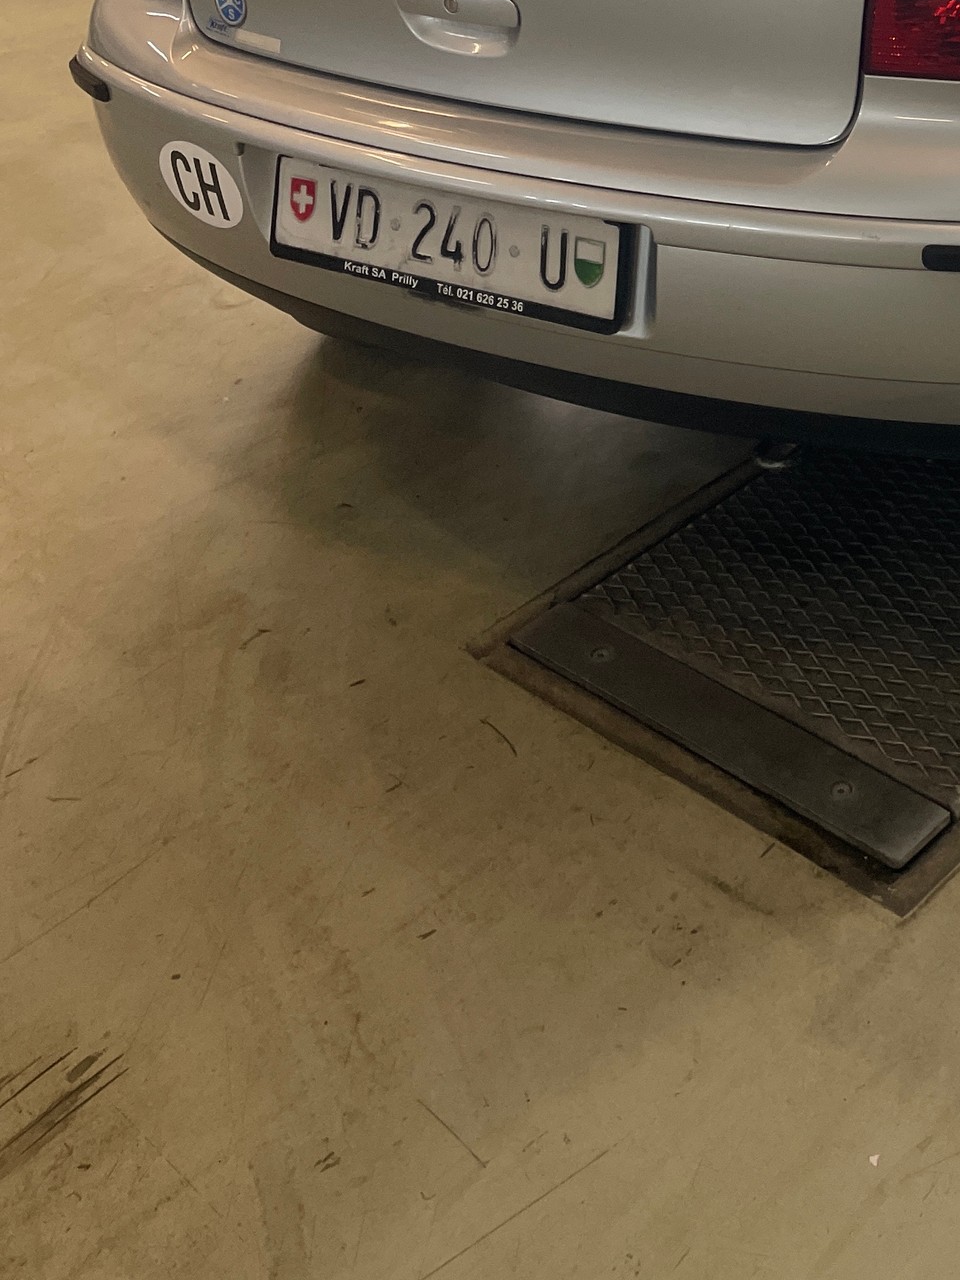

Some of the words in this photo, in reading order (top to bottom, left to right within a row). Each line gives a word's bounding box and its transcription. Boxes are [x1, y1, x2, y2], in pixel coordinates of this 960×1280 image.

[170, 150, 230, 221] CH
[330, 179, 381, 249] VD
[411, 199, 496, 275] 240
[539, 224, 569, 291] U
[344, 261, 370, 275] Kraft
[371, 268, 386, 279] SA
[391, 272, 419, 288] Prilly
[436, 283, 454, 297] Tél.
[456, 288, 473, 301] 021
[476, 293, 494, 306] 626
[496, 297, 509, 309] 25
[511, 300, 524, 312] 36
